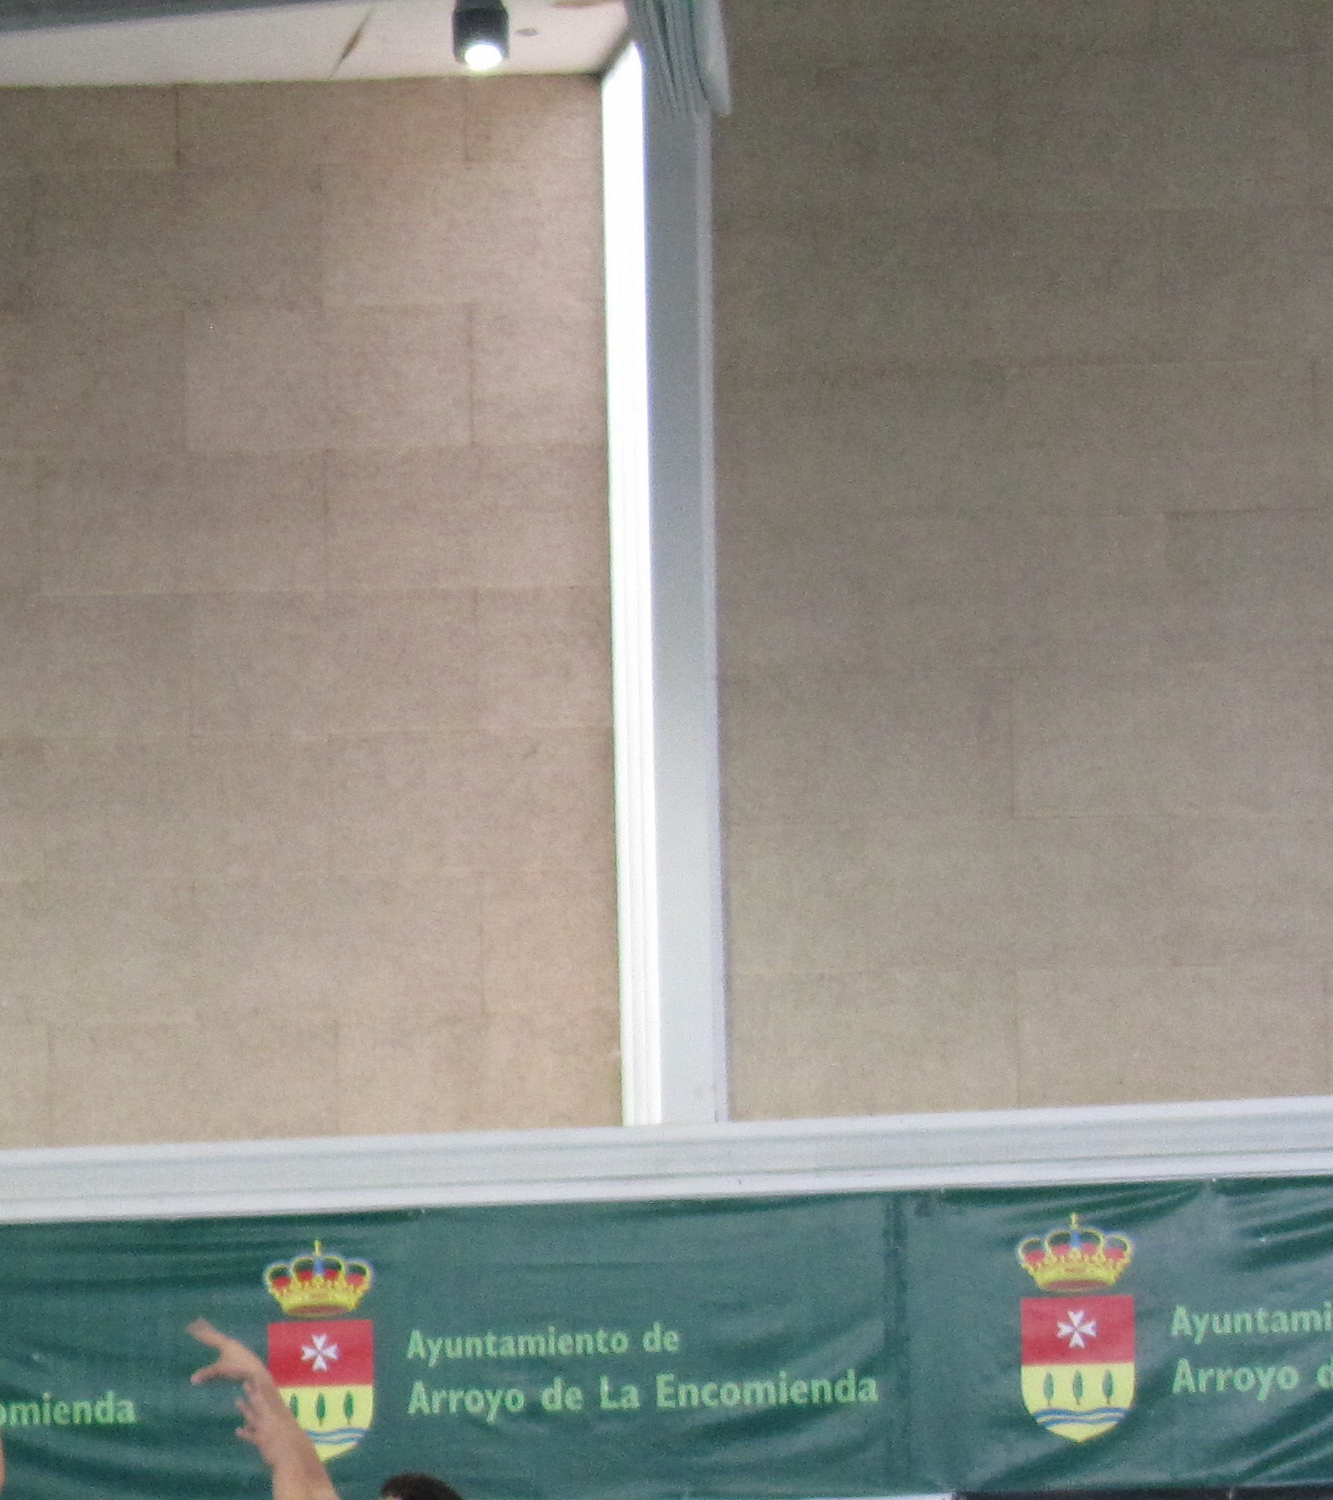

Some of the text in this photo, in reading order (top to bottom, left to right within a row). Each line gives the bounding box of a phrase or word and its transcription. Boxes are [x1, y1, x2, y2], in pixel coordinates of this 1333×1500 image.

[407, 1322, 680, 1367] Ayuntamiento de
[408, 1369, 879, 1424] Arroyo de La Encomienda
[1171, 1358, 1300, 1402] Arroyo
